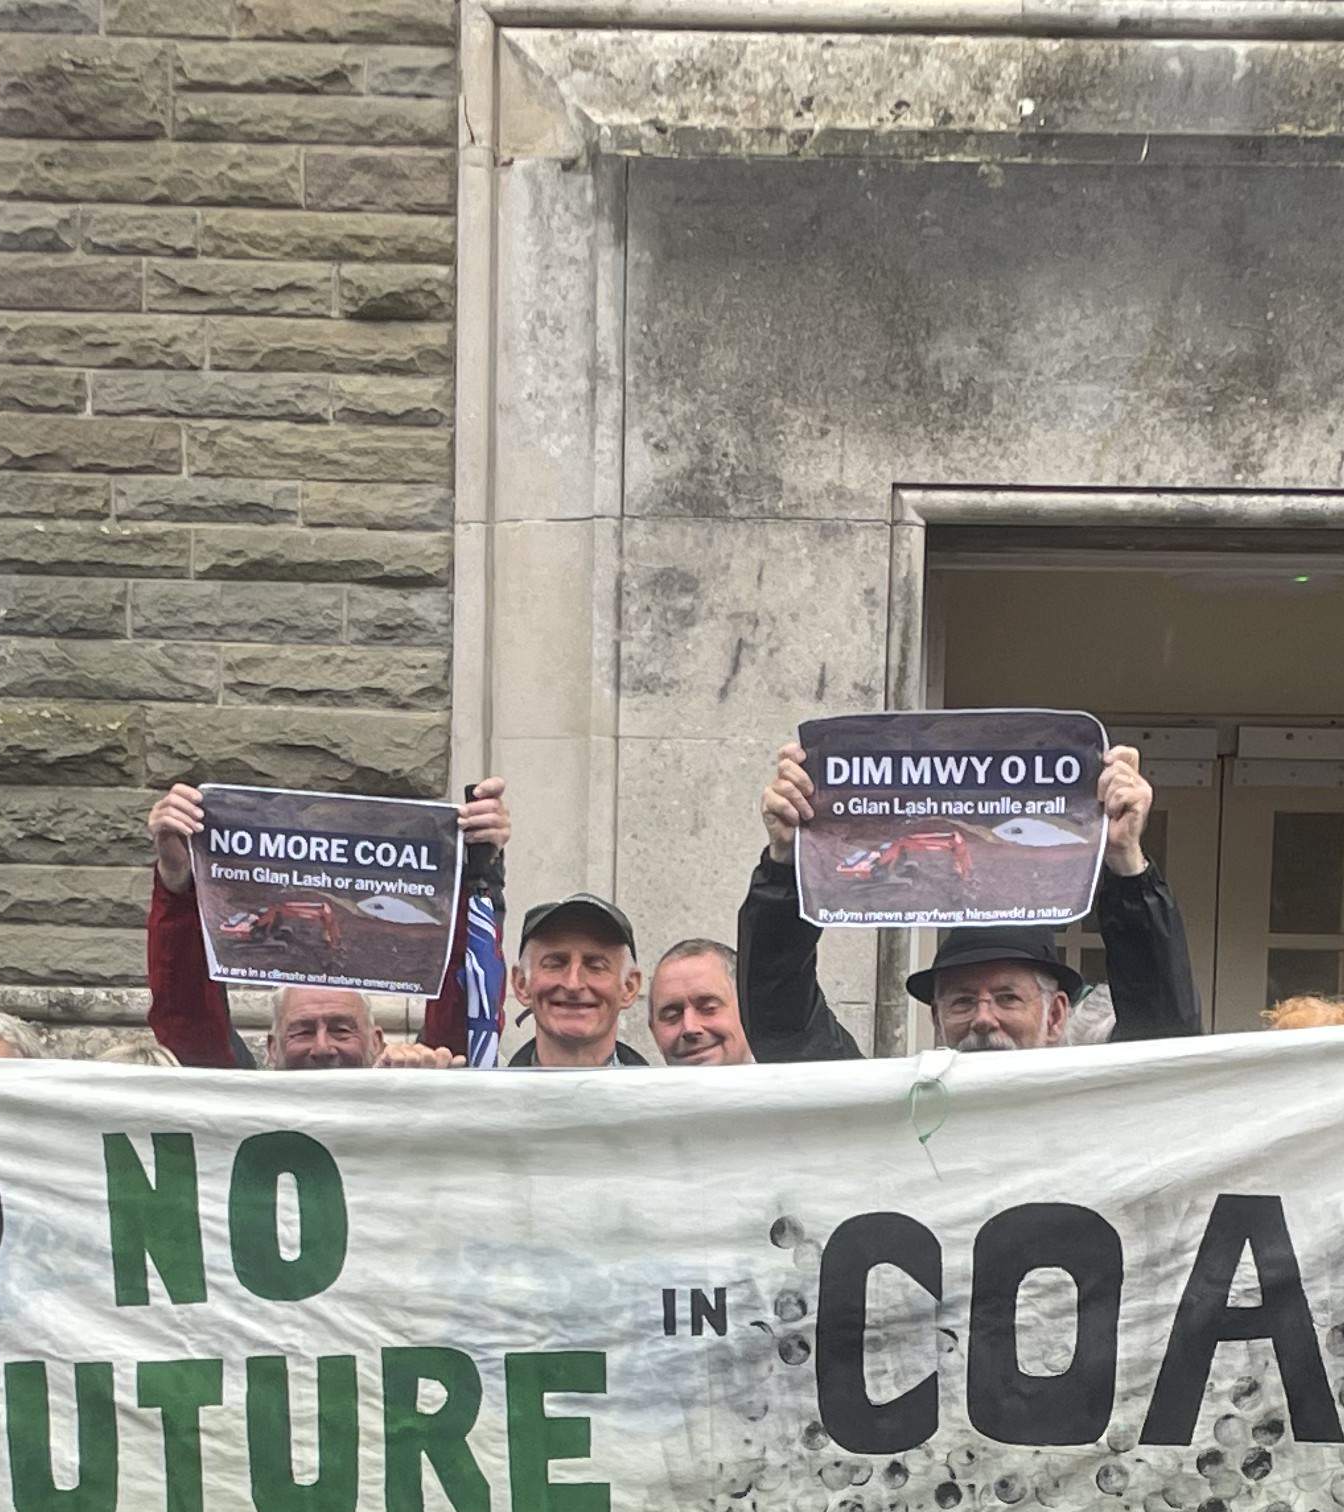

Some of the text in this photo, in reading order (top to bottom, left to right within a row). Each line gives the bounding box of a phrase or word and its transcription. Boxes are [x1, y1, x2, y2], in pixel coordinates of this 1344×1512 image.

[826, 755, 1081, 785] DIM MWY O LO
[832, 797, 1066, 816] o Glan Lash nac unlle arall
[210, 829, 438, 871] NO MORE COAL
[211, 864, 435, 897] from Glan Lash or anywhere
[819, 909, 862, 923] Rydym
[865, 911, 903, 922] mewn
[965, 907, 1026, 920] hinsawdd
[1027, 910, 1035, 919] a
[230, 967, 246, 977] are
[248, 966, 258, 977] in
[260, 969, 266, 978] a
[268, 969, 306, 982] climate
[307, 973, 326, 983] and
[328, 975, 362, 986] nature
[103, 1129, 349, 1307] NO
[661, 1287, 727, 1337] IN
